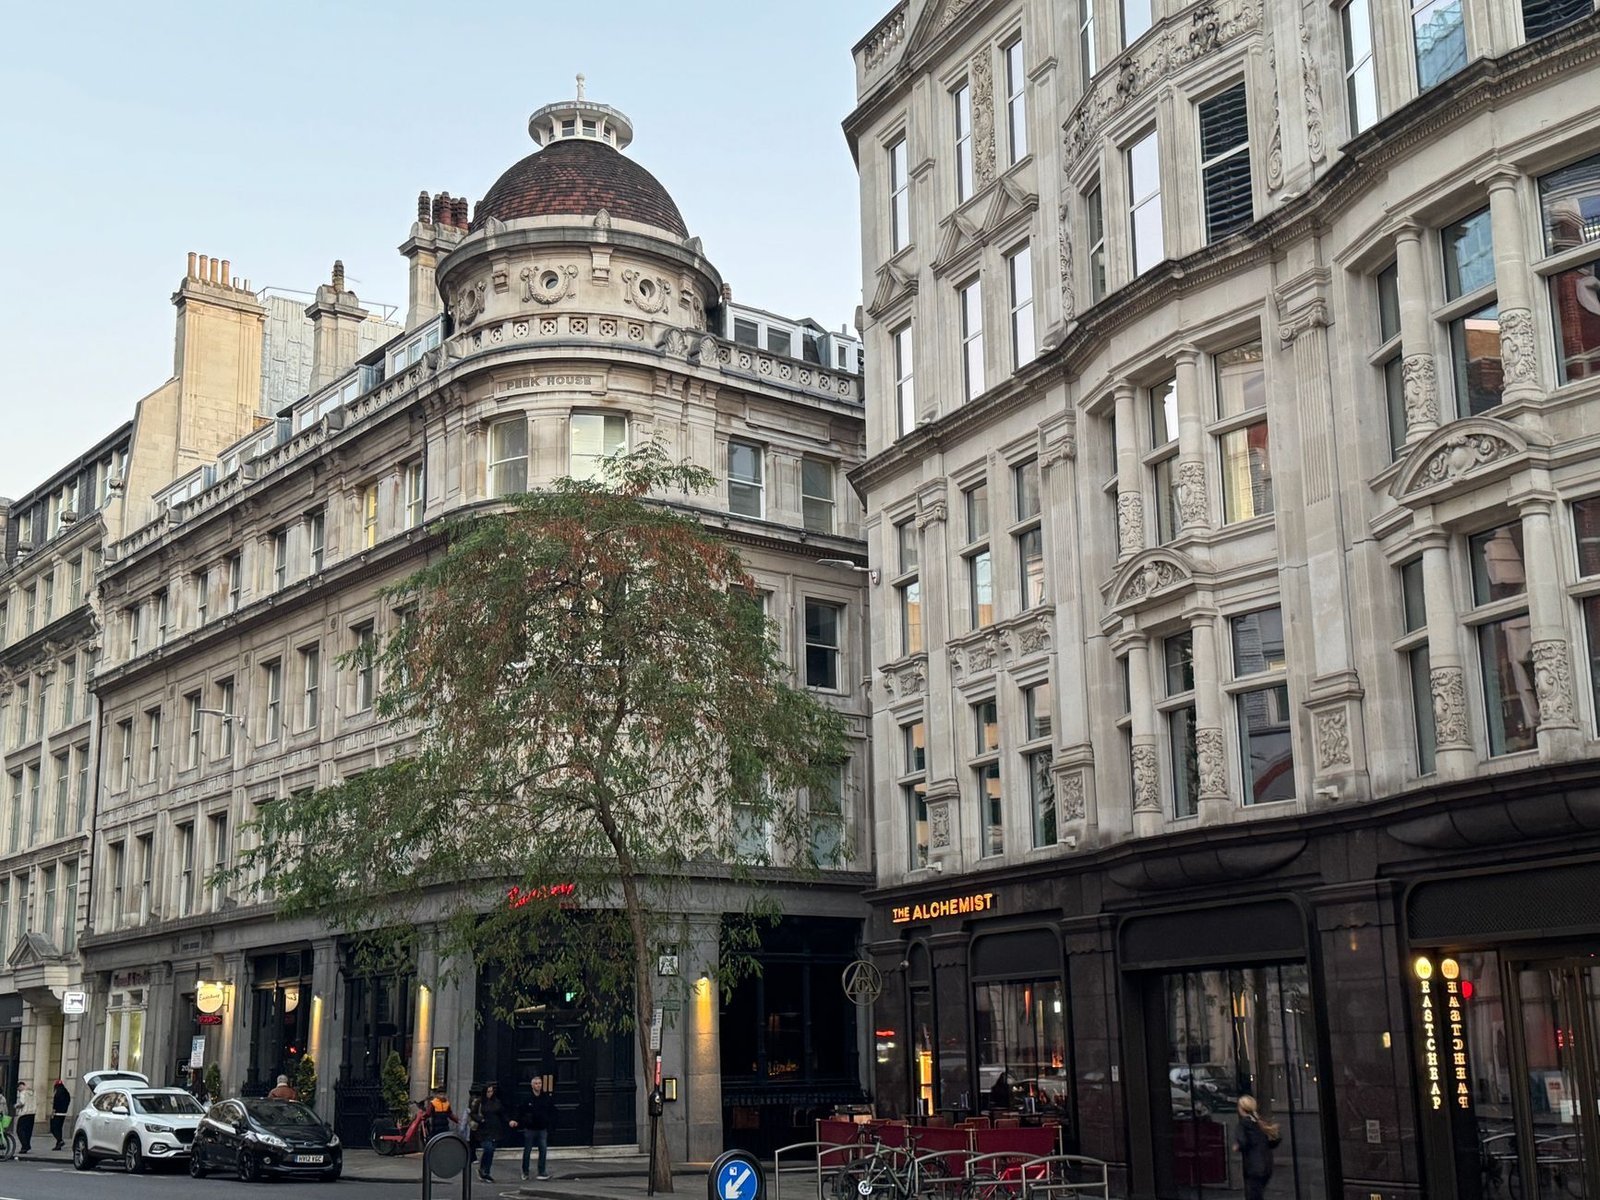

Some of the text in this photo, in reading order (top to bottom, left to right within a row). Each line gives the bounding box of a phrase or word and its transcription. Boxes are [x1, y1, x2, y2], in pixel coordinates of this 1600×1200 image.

[506, 375, 592, 390] PEEK HOUSE
[892, 893, 993, 920] THE ALCHEMIST
[1420, 980, 1442, 1110] EASTCHEAP
